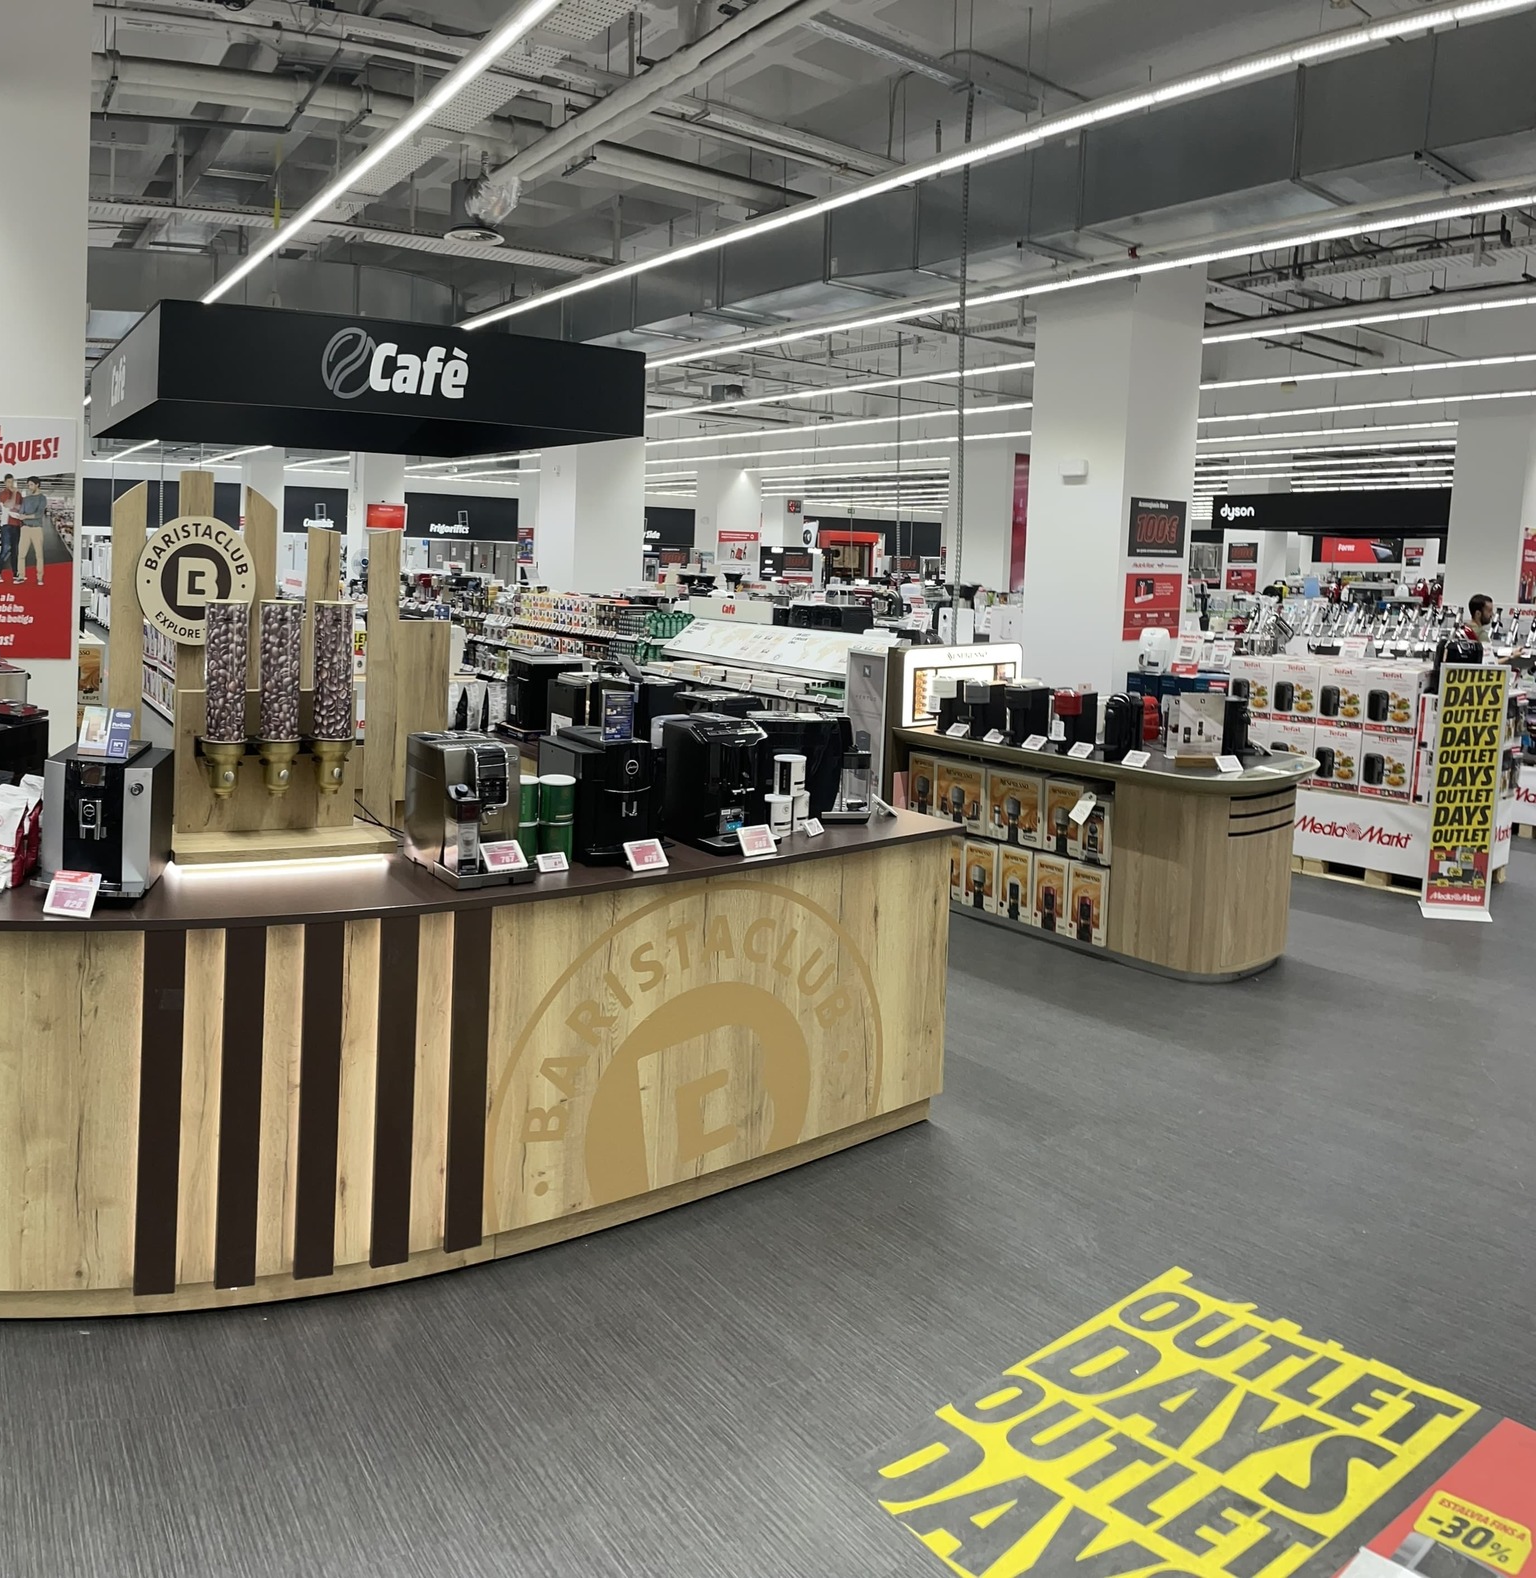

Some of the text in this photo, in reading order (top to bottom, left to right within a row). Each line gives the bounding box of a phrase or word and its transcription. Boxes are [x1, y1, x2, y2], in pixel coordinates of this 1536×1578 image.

[369, 342, 469, 399] Cafè
[1220, 503, 1255, 521] dyson
[144, 523, 249, 576] BARISTACLUB
[6, 593, 15, 602] la
[155, 611, 201, 639] EXPLORE
[1287, 664, 1306, 672] Tefal
[1382, 672, 1403, 680] Tefal
[1446, 668, 1503, 684] OUTLET
[1443, 684, 1502, 708] DAYS
[1442, 708, 1501, 725] OUTLET
[1440, 725, 1498, 748] DAYS
[1439, 748, 1497, 765] OUTLET
[1437, 765, 1495, 788] DAYS
[1435, 788, 1493, 804] OUTLET
[1433, 805, 1491, 827] DAYS
[1294, 815, 1412, 849] Media Markt
[1432, 828, 1489, 844] OUTLET
[520, 914, 852, 1143] BARISTACLUB
[1118, 1291, 1465, 1448] OUTLET
[1022, 1323, 1399, 1516] DAYS
[952, 1373, 1330, 1578] OUTLET
[1439, 1497, 1526, 1541] ESTALVIA FINS A
[1427, 1515, 1512, 1563] -30%
